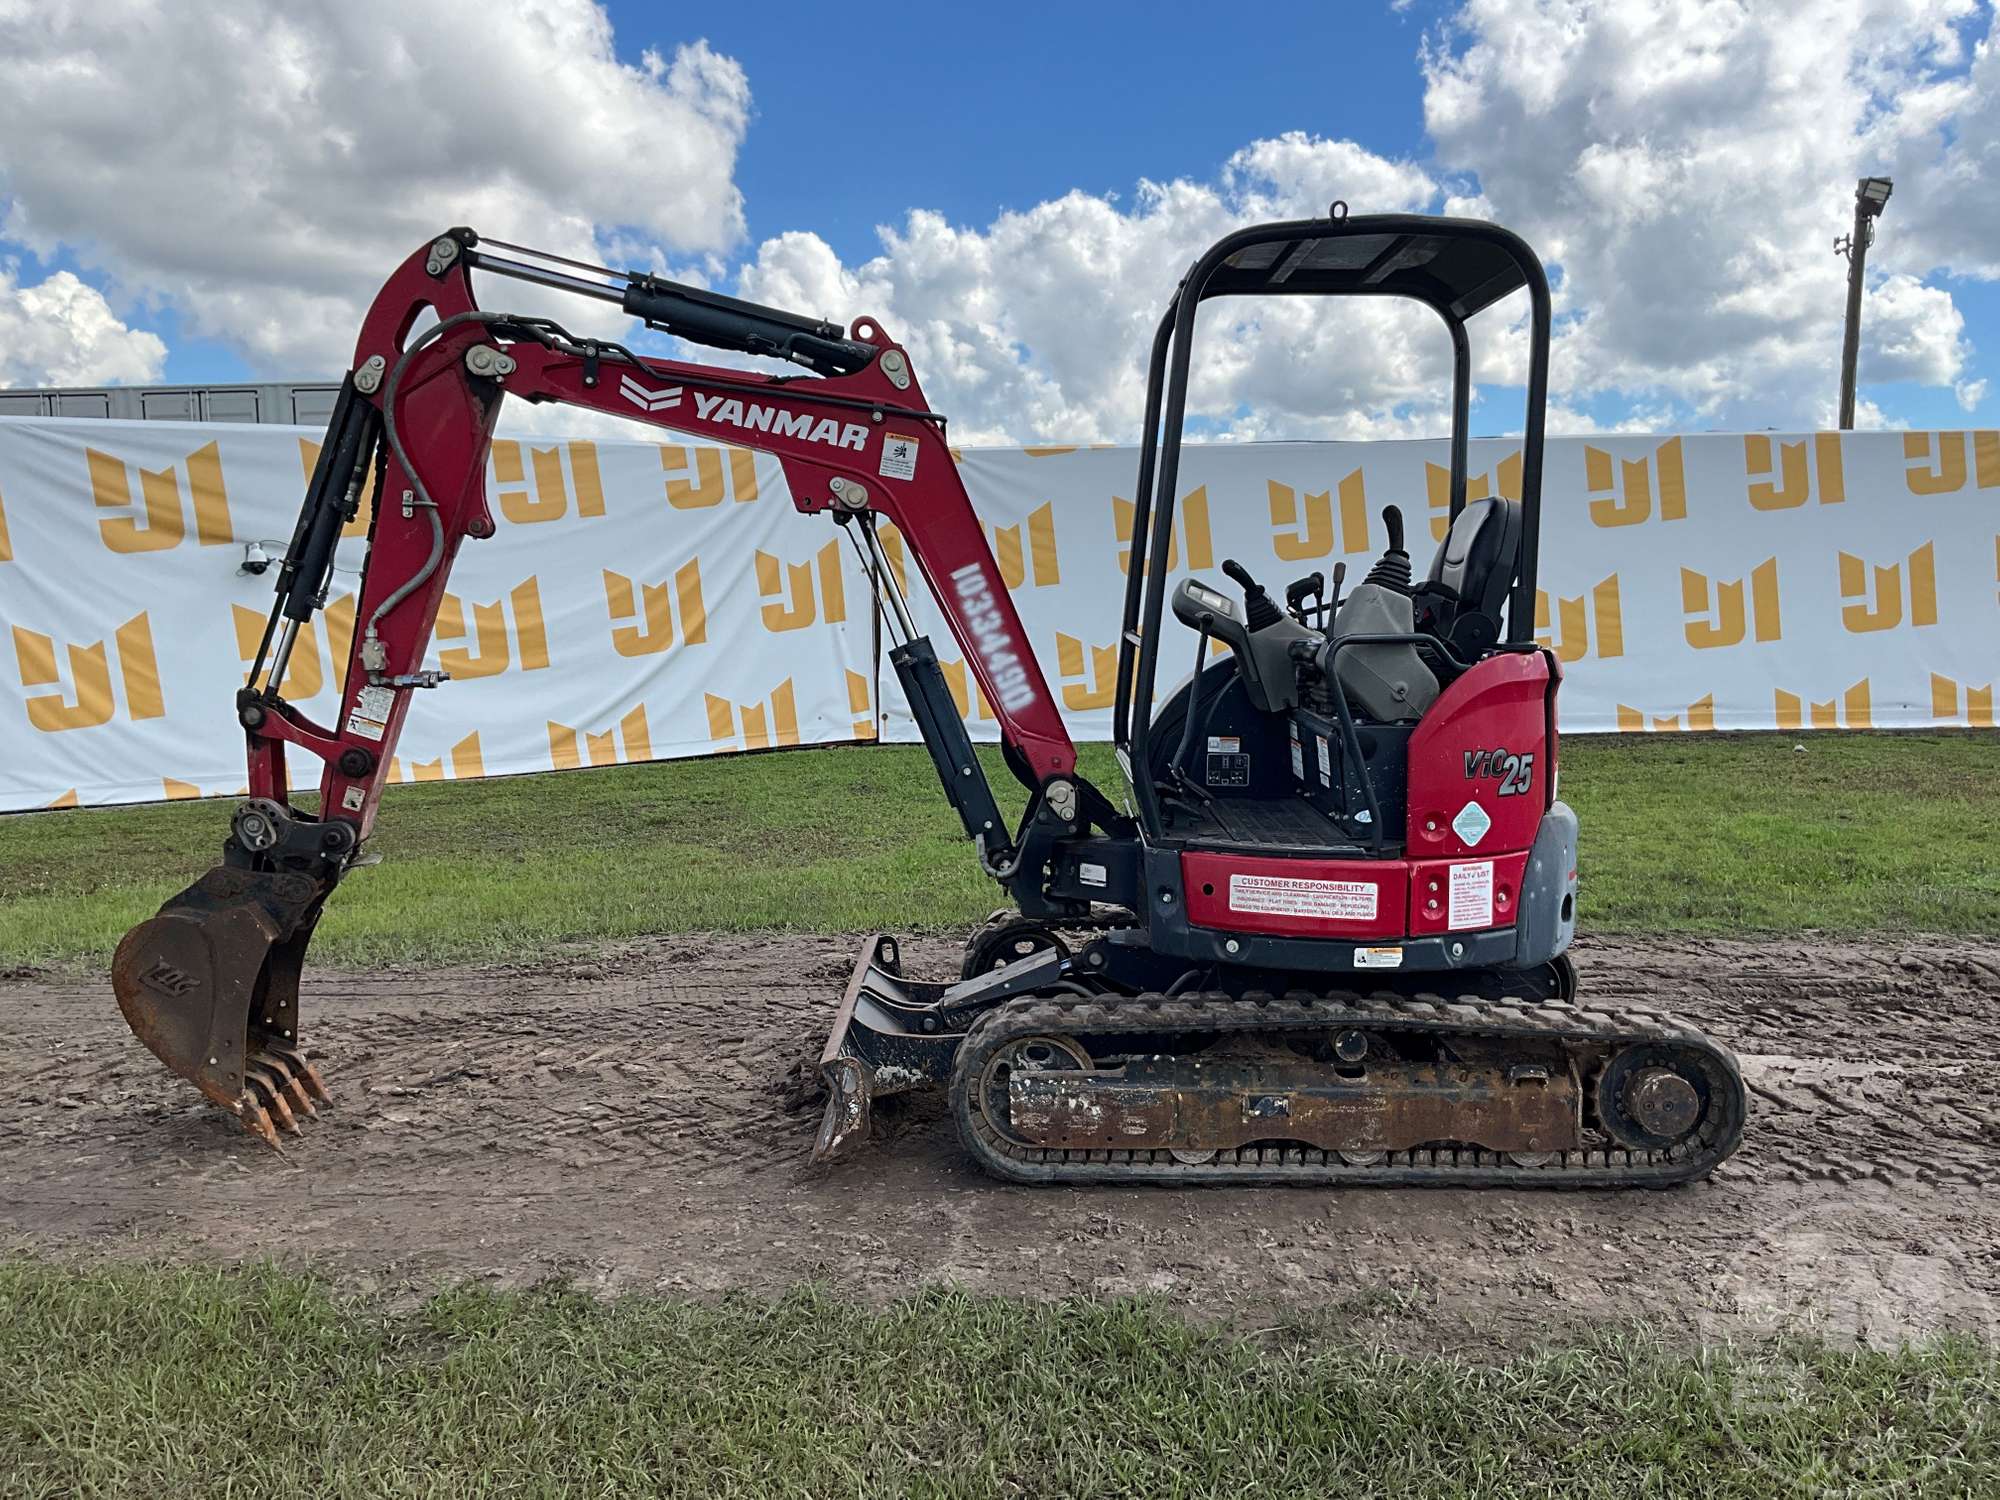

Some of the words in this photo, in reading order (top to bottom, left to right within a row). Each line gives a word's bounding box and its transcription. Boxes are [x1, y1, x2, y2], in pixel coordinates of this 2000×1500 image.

[693, 392, 869, 451] YANMAR
[949, 562, 1037, 714] 10334490
[1241, 878, 1290, 888] CUSTOMER
[1292, 881, 1365, 891] RESPONSIBILITY
[1453, 872, 1471, 880] DAILY
